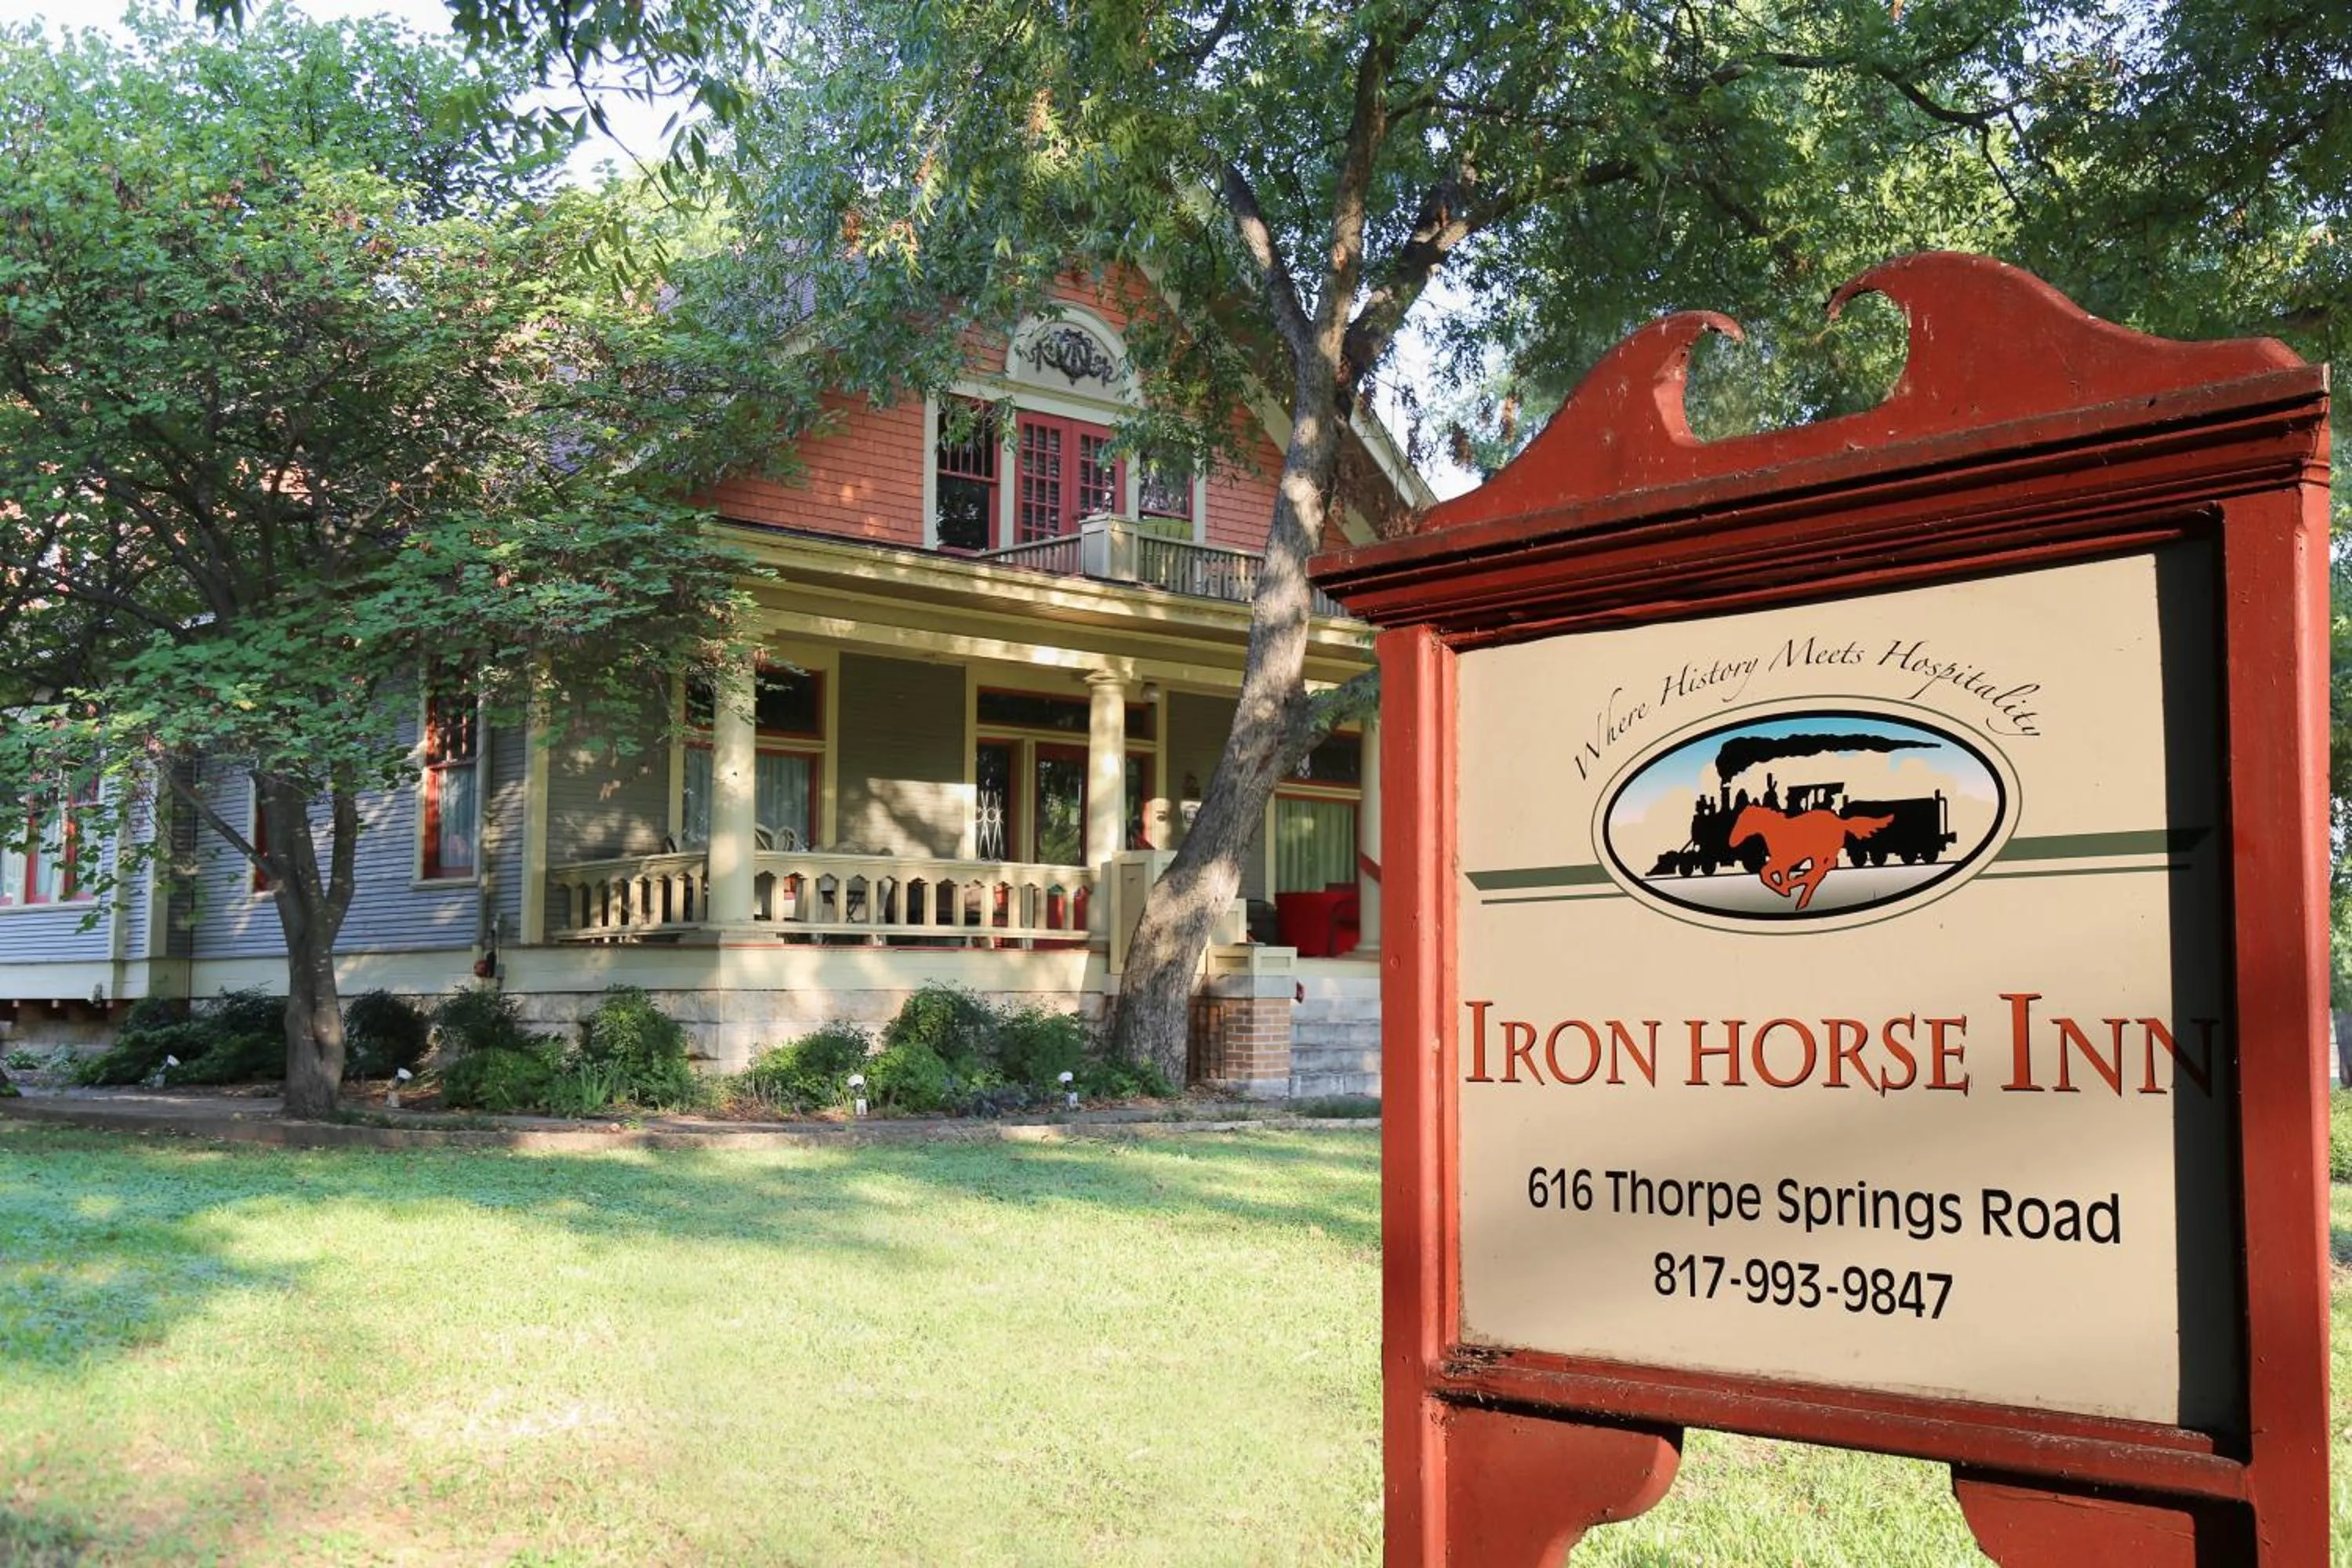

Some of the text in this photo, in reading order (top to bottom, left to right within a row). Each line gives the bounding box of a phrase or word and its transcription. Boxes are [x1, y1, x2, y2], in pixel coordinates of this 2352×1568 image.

[1573, 636, 2042, 782] Where History Meets Hospitality
[1464, 992, 2221, 1099] IRON HORSE INN
[1527, 1166, 2122, 1245] 616 Thorpe Springs Road
[1653, 1250, 1954, 1320] 817-993-9847
